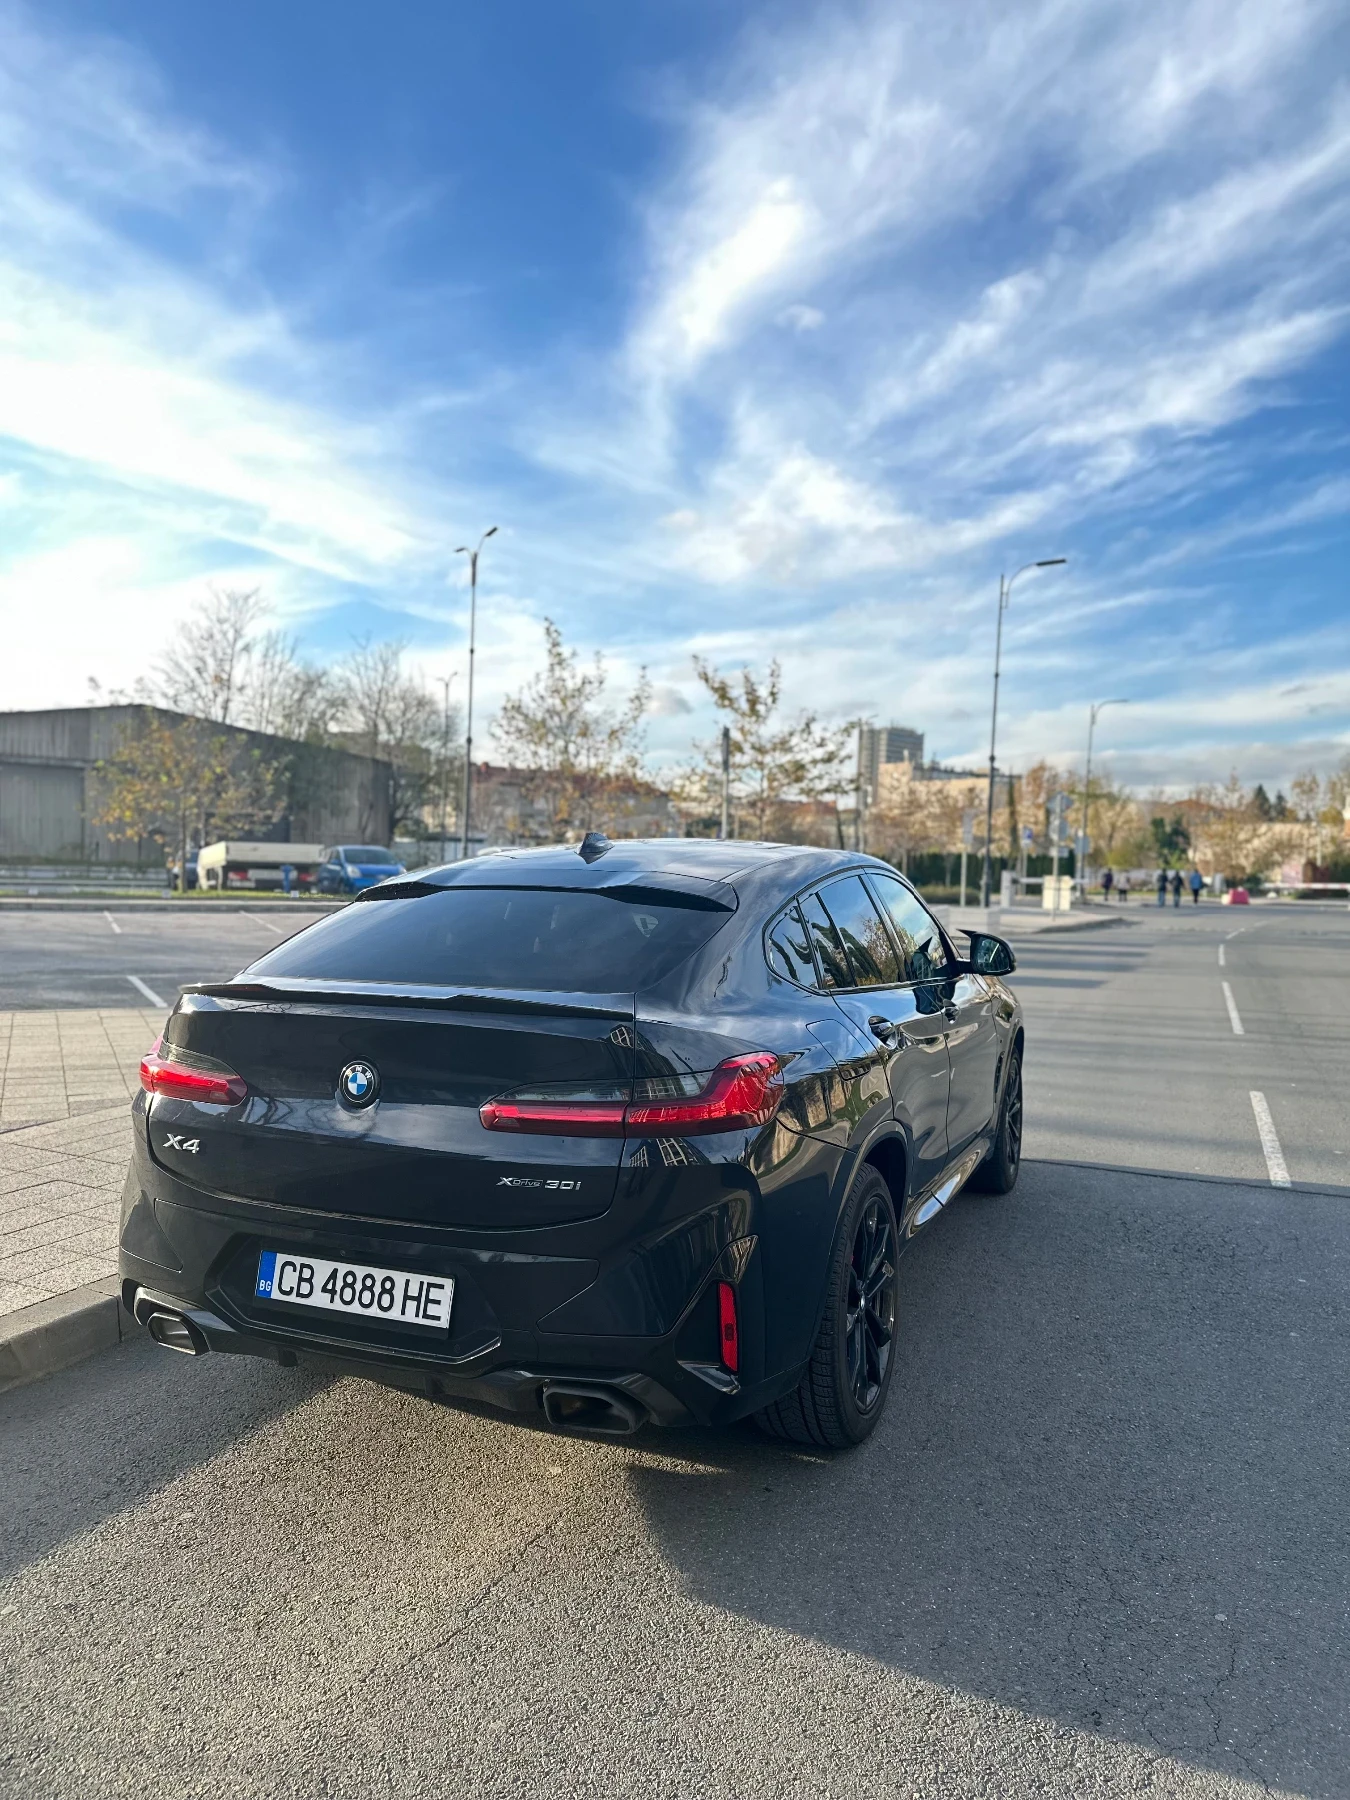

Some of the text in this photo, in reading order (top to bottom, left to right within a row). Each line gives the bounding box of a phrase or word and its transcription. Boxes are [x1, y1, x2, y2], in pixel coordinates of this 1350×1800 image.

[162, 1133, 200, 1154] X4
[259, 1279, 272, 1291] BG
[277, 1260, 445, 1322] CB 4888 HE
